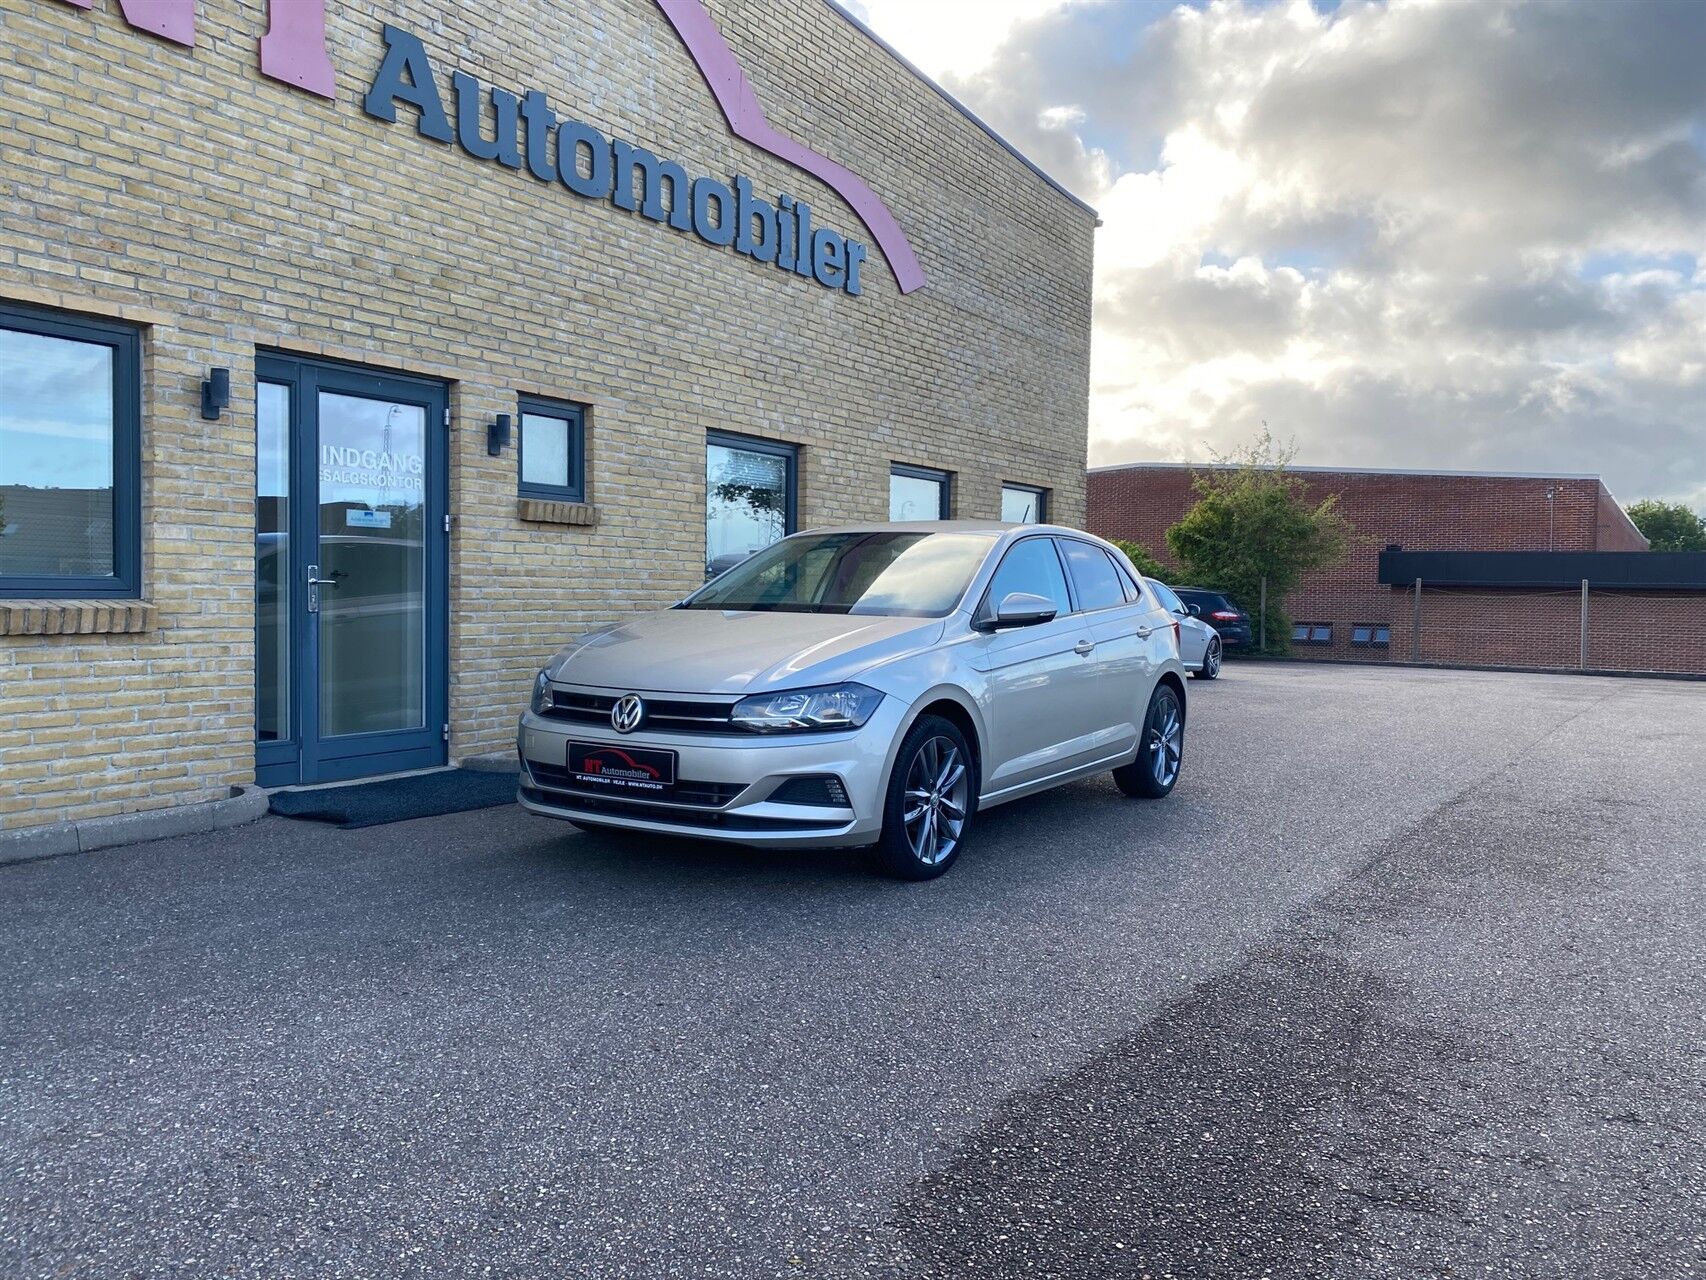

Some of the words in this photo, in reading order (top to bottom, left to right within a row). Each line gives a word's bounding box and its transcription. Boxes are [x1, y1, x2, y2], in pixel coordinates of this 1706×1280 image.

[364, 24, 868, 295] Automobiler
[322, 444, 422, 474] INDGANG
[322, 468, 422, 490] SALGSKONTOR
[601, 766, 650, 779] Automobiler
